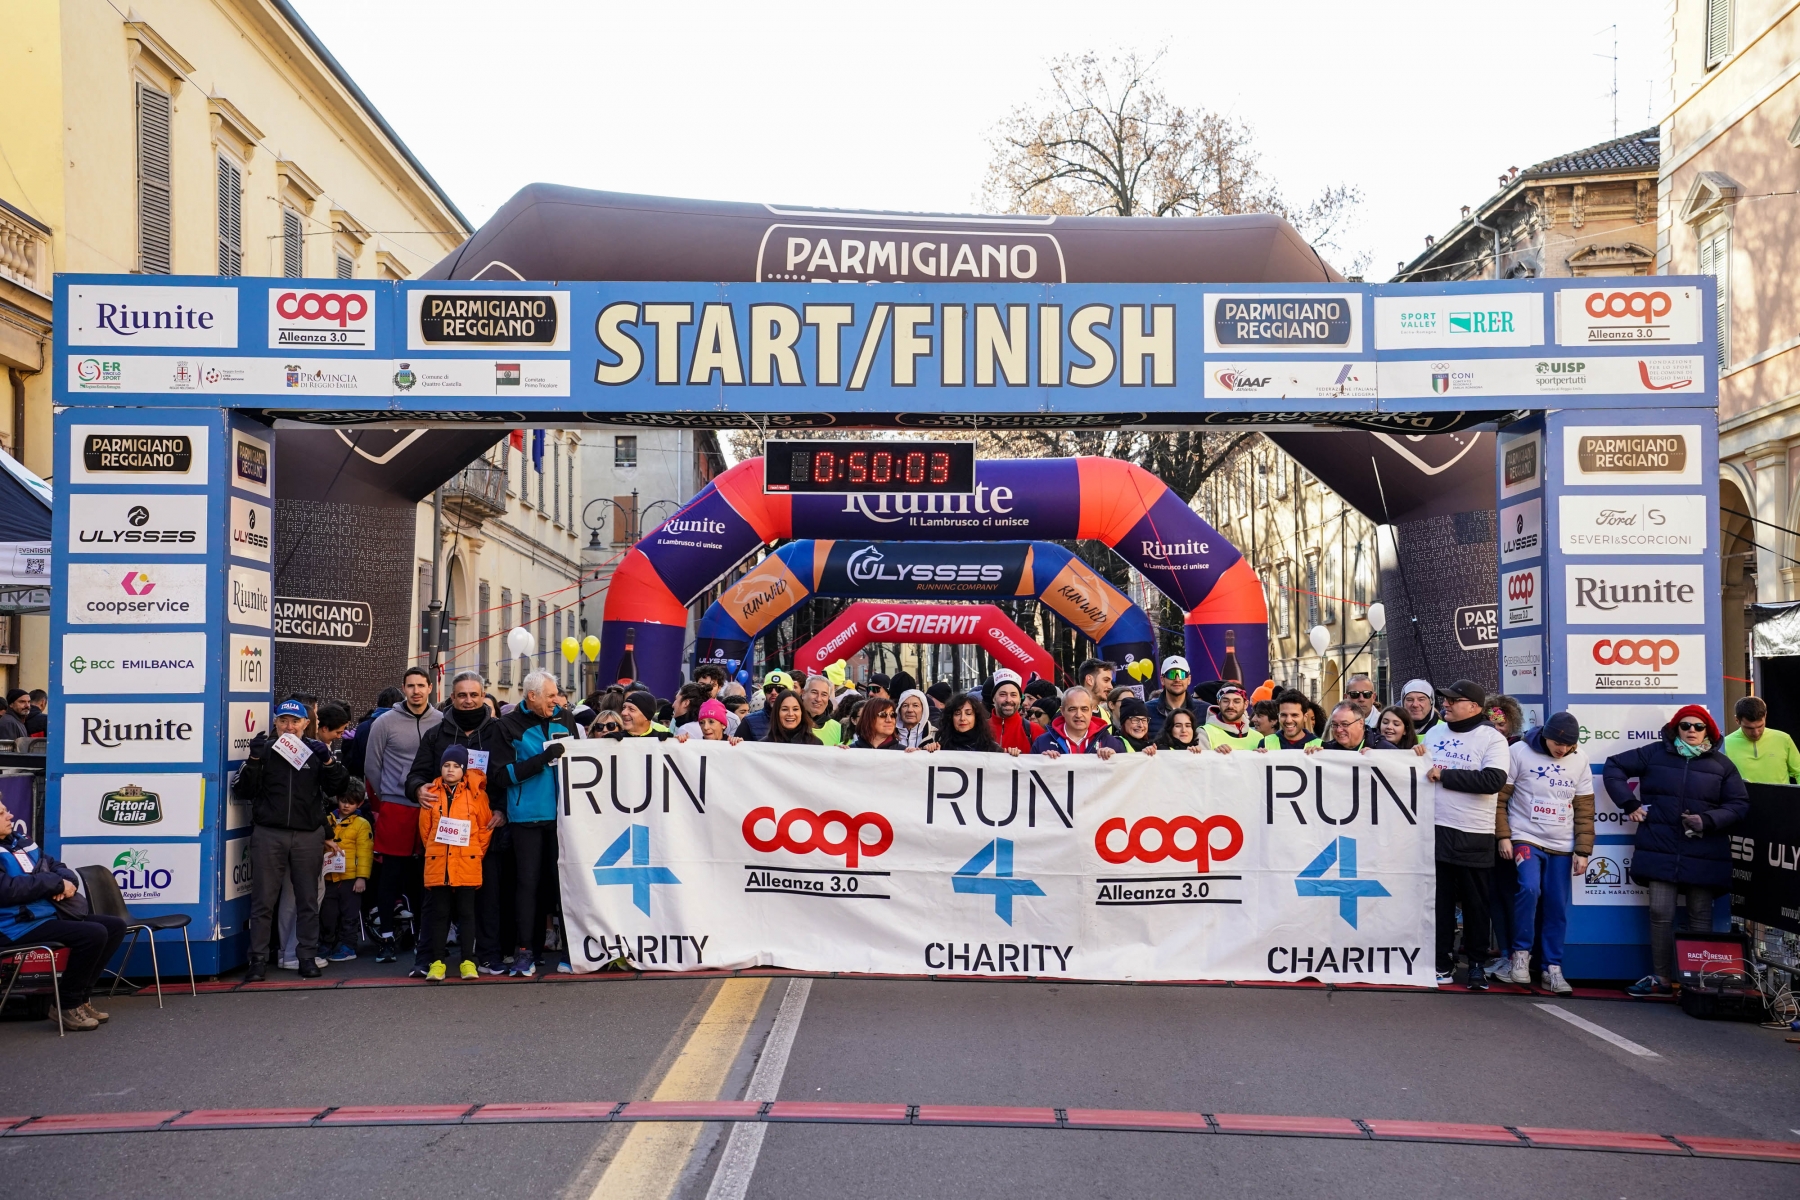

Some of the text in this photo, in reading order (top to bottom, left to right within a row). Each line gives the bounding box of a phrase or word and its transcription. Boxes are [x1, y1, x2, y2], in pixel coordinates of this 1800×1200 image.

[787, 236, 1038, 278] PARMIGIANO
[276, 292, 368, 328] coop
[432, 300, 546, 318] PARMIGIANO
[1225, 302, 1340, 320] PARMIGIANO
[1585, 291, 1672, 324] coop
[96, 302, 214, 336] Riunite
[442, 320, 535, 336] REGGIANO
[279, 331, 348, 342] Alleanza 3.0
[1236, 322, 1329, 339] REGGIANO
[1588, 329, 1653, 338] Alleanza 3.0
[594, 301, 1177, 392] START/FINISH
[1550, 362, 1586, 373] UISP
[300, 373, 357, 383] PROVINCIA
[1237, 378, 1272, 387] IAAF
[1536, 376, 1586, 386] sportpertutti
[92, 438, 183, 452] PARMIGIANO
[1587, 438, 1678, 452] PARMIGIANO
[101, 453, 174, 467] REGGIANO
[814, 451, 950, 484] 0:50:03
[1596, 453, 1669, 468] REGGIANO
[661, 518, 726, 534] Riunite
[910, 517, 1030, 527] Il Lambrusco ci unisce
[1596, 509, 1637, 526] Ford
[80, 530, 196, 543] ULYSSES
[234, 528, 268, 548] ULYSSES
[663, 538, 695, 547] Lambrusco
[1504, 534, 1538, 554] ULYSSES
[1570, 534, 1692, 545] SEVERI&SCORCIONI
[1141, 539, 1209, 560] Riunite
[854, 563, 1004, 581] ULYSSES
[233, 580, 268, 614] Riunite
[1508, 572, 1534, 605] coop
[1575, 578, 1695, 611] Riunite
[86, 599, 190, 615] coopservice
[274, 602, 363, 623] ARMIGIANO
[743, 594, 763, 620] RUN
[274, 619, 353, 638] REGGIANO
[896, 614, 981, 635] ENERVIT
[826, 622, 858, 654] ENERVIT
[998, 634, 1035, 664] ENERVIT
[1592, 639, 1680, 672] coop
[90, 660, 194, 669] BCC EMILBANCA
[698, 658, 741, 666] ULYSSS
[1596, 676, 1661, 687] Alleanza 3.0
[81, 717, 192, 747] Riunite
[1594, 730, 1663, 740] BCC EMILB
[561, 754, 707, 816] RUN
[926, 765, 1074, 828] RUN
[1266, 765, 1417, 825] RUN
[106, 799, 155, 811] Fattoria
[1534, 806, 1556, 815] 0491
[114, 810, 146, 822] Italia
[440, 826, 458, 835] 0496
[742, 806, 894, 868] coop
[1094, 814, 1244, 874] coop
[112, 869, 171, 889] GLIO
[592, 823, 683, 918] 4
[1731, 868, 1752, 881] OMPANY
[747, 871, 859, 893] Alleanza 3.0
[951, 837, 1047, 927] 4
[1098, 882, 1210, 900] Alleanza 3.0
[1294, 835, 1392, 931] 4
[924, 942, 1073, 972] CHARITY
[1268, 946, 1421, 975] CHARITY
